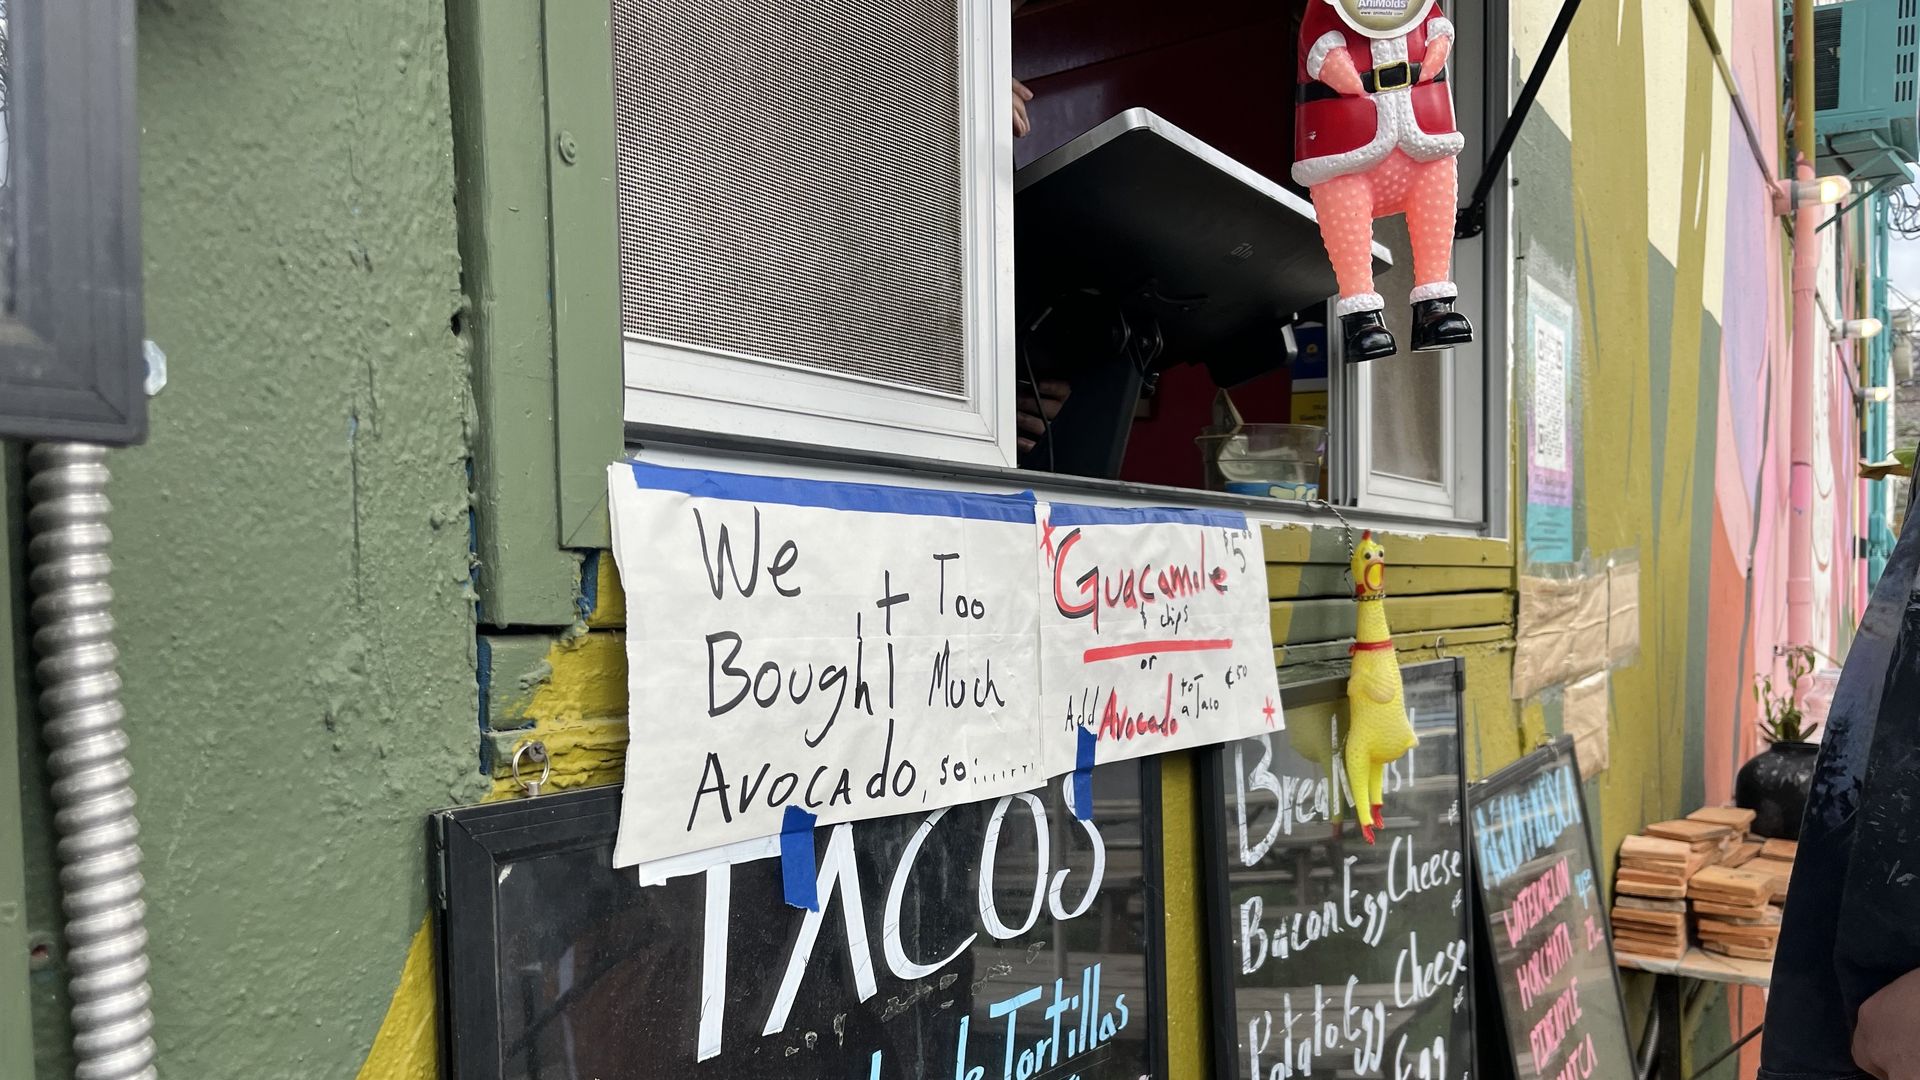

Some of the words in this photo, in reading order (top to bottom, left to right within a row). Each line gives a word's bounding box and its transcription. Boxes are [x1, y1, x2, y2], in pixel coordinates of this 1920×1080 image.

[693, 506, 801, 599] We
[932, 552, 986, 620] Too
[1053, 527, 1228, 635] Guacamole
[705, 569, 910, 748] Bought
[1160, 604, 1189, 635] chips
[928, 639, 1006, 709] Much
[1140, 655, 1158, 670] or
[1065, 686, 1100, 732] Add
[1097, 671, 1179, 742] Avocado
[1388, 834, 1463, 902] Cheese
[1503, 856, 1571, 948] WATERMELON
[639, 772, 1107, 1064] TACOS
[1394, 931, 1468, 1009] Cheese
[1516, 922, 1574, 1012] HORCHATA
[989, 962, 1130, 1080] Tortillas
